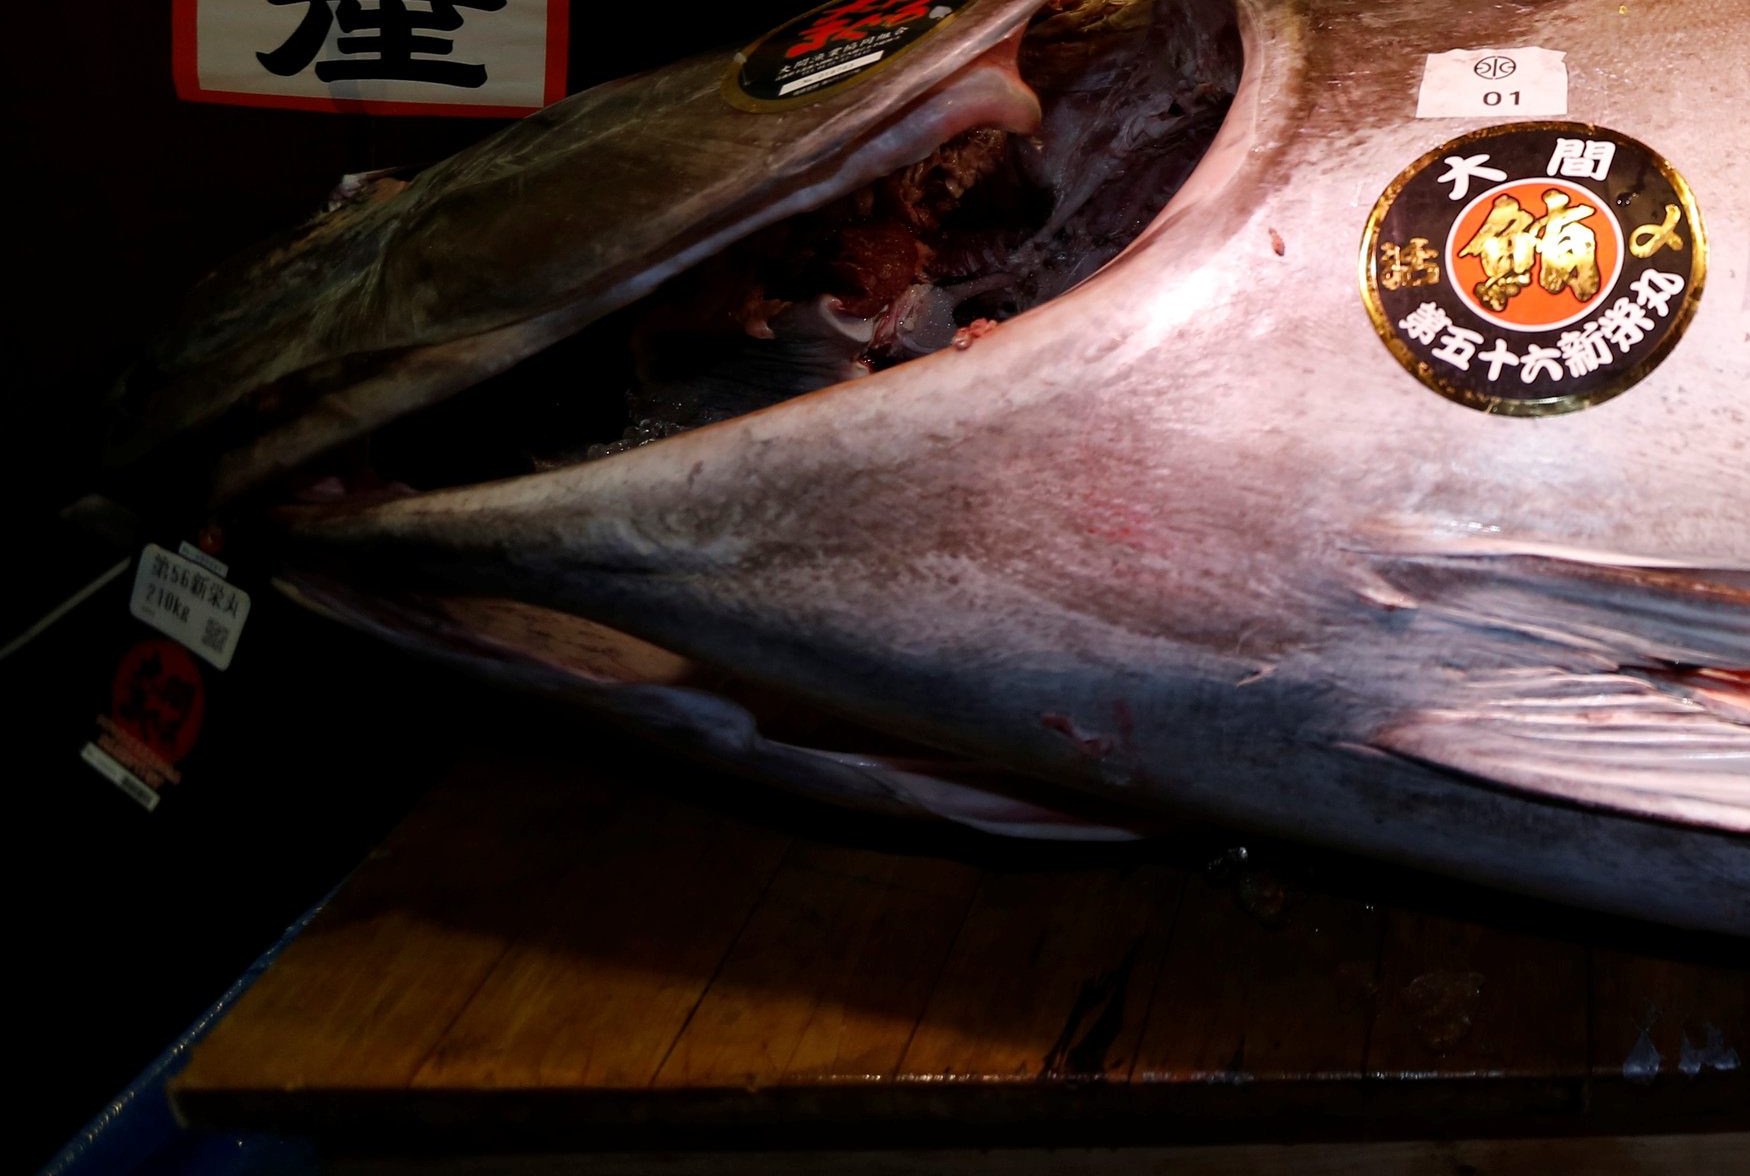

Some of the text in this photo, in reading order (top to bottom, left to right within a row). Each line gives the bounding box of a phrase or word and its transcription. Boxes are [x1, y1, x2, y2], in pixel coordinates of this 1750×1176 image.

[1482, 90, 1521, 106] 01
[1437, 138, 1616, 201] 大間
[1458, 188, 1602, 312] 鮪
